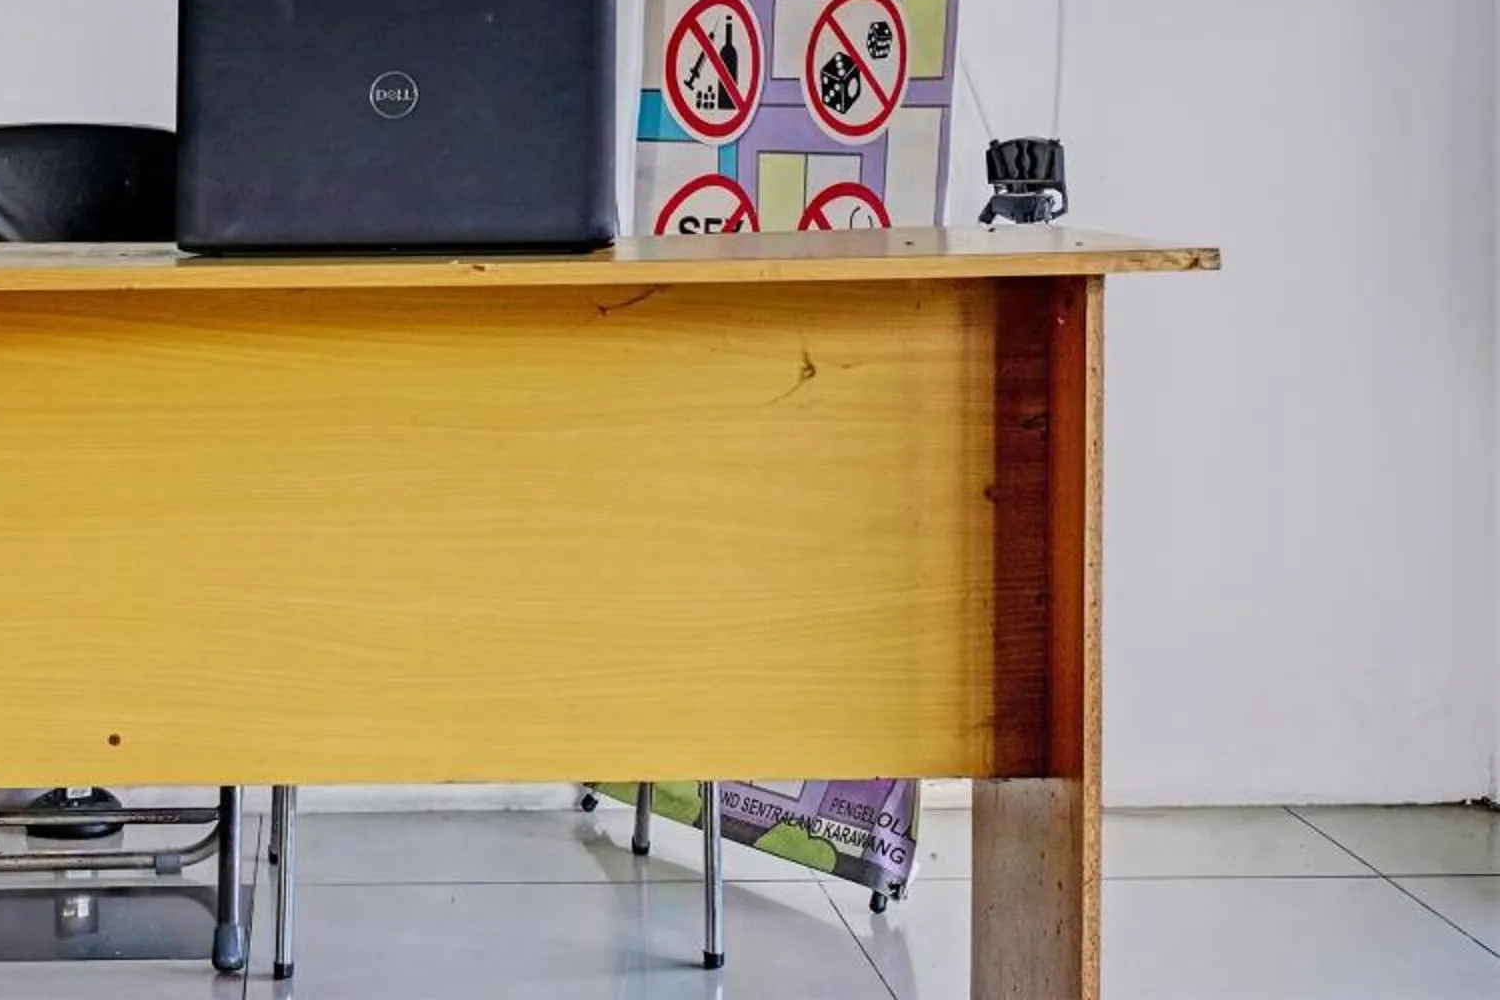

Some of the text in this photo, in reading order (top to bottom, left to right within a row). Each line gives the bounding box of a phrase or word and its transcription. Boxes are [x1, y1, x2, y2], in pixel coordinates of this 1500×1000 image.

[376, 88, 412, 101] DELL
[741, 796, 823, 834] SENTRALAND
[823, 822, 907, 864] KARAWANG
